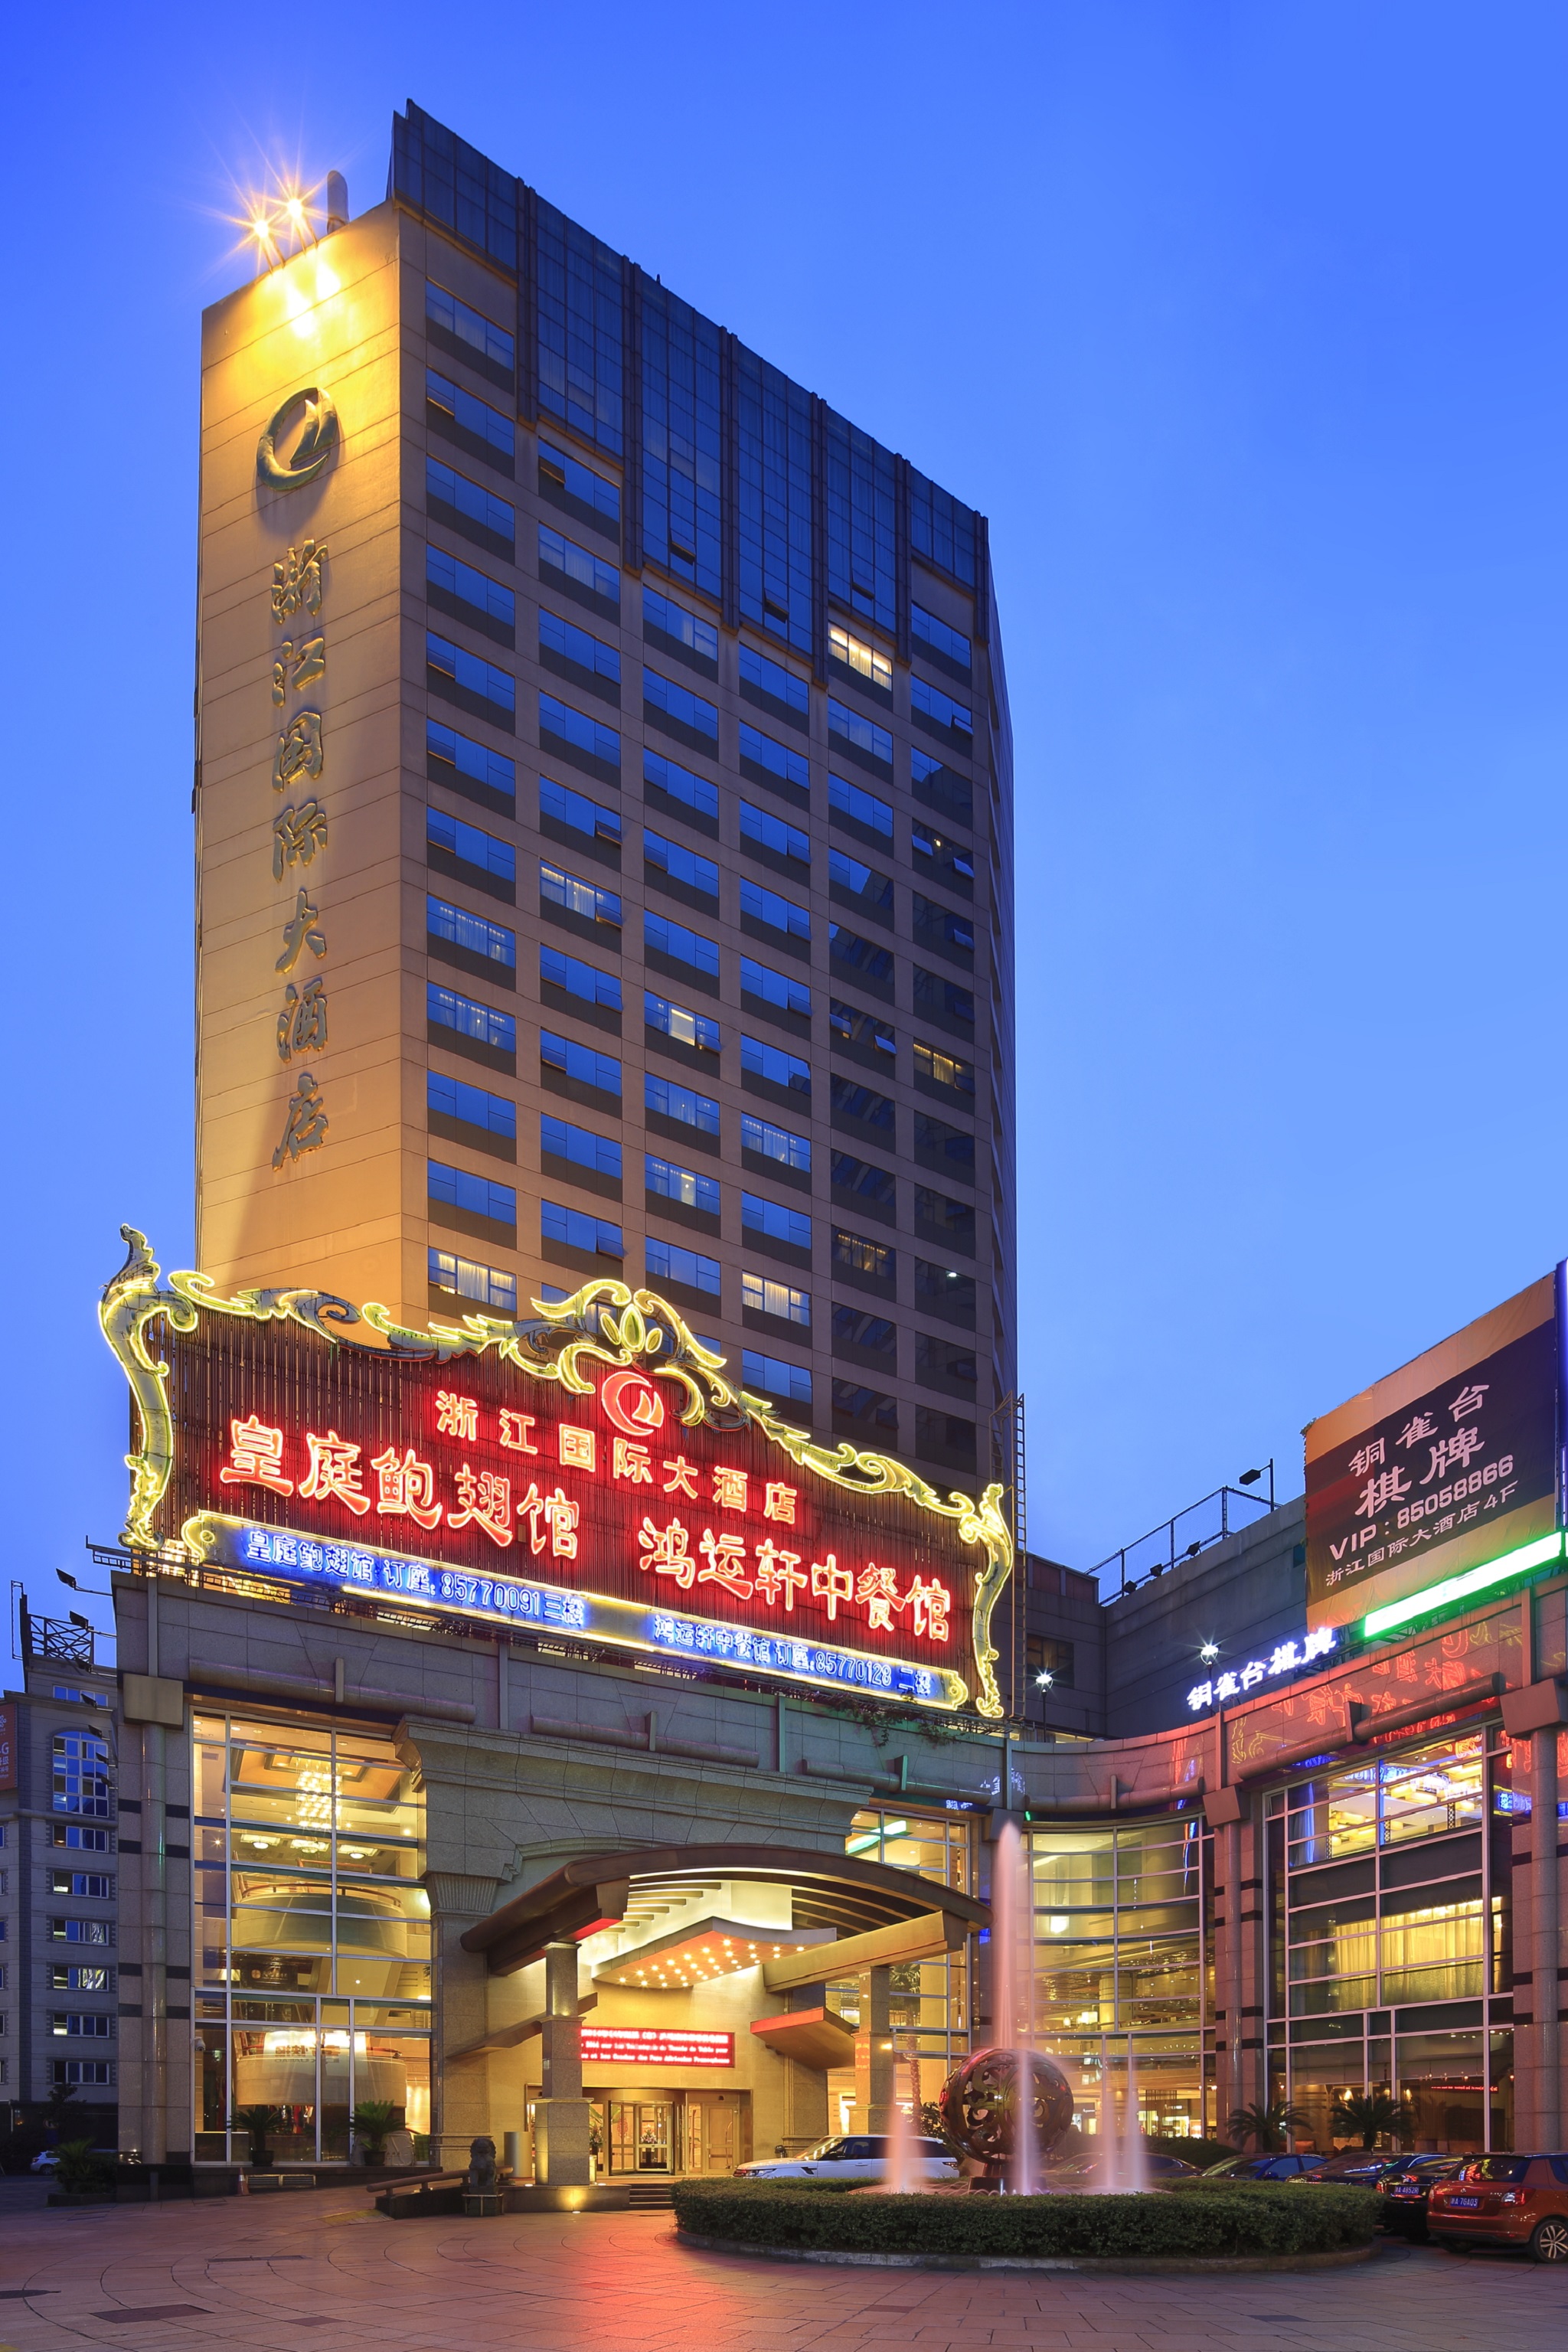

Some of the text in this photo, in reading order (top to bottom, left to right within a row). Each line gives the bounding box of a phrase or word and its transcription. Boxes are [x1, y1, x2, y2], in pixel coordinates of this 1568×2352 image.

[436, 1390, 798, 1524] 浙江国际大酒店
[1348, 1384, 1490, 1478] 铜雀台
[1354, 1426, 1485, 1518] 棋牌
[220, 1414, 580, 1560] 皇庭鲍翅馆
[1396, 1454, 1514, 1530] 85058866
[638, 1516, 951, 1642] 鸿运轩中餐馆
[1186, 1627, 1337, 1711] 铜雀台棋牌
